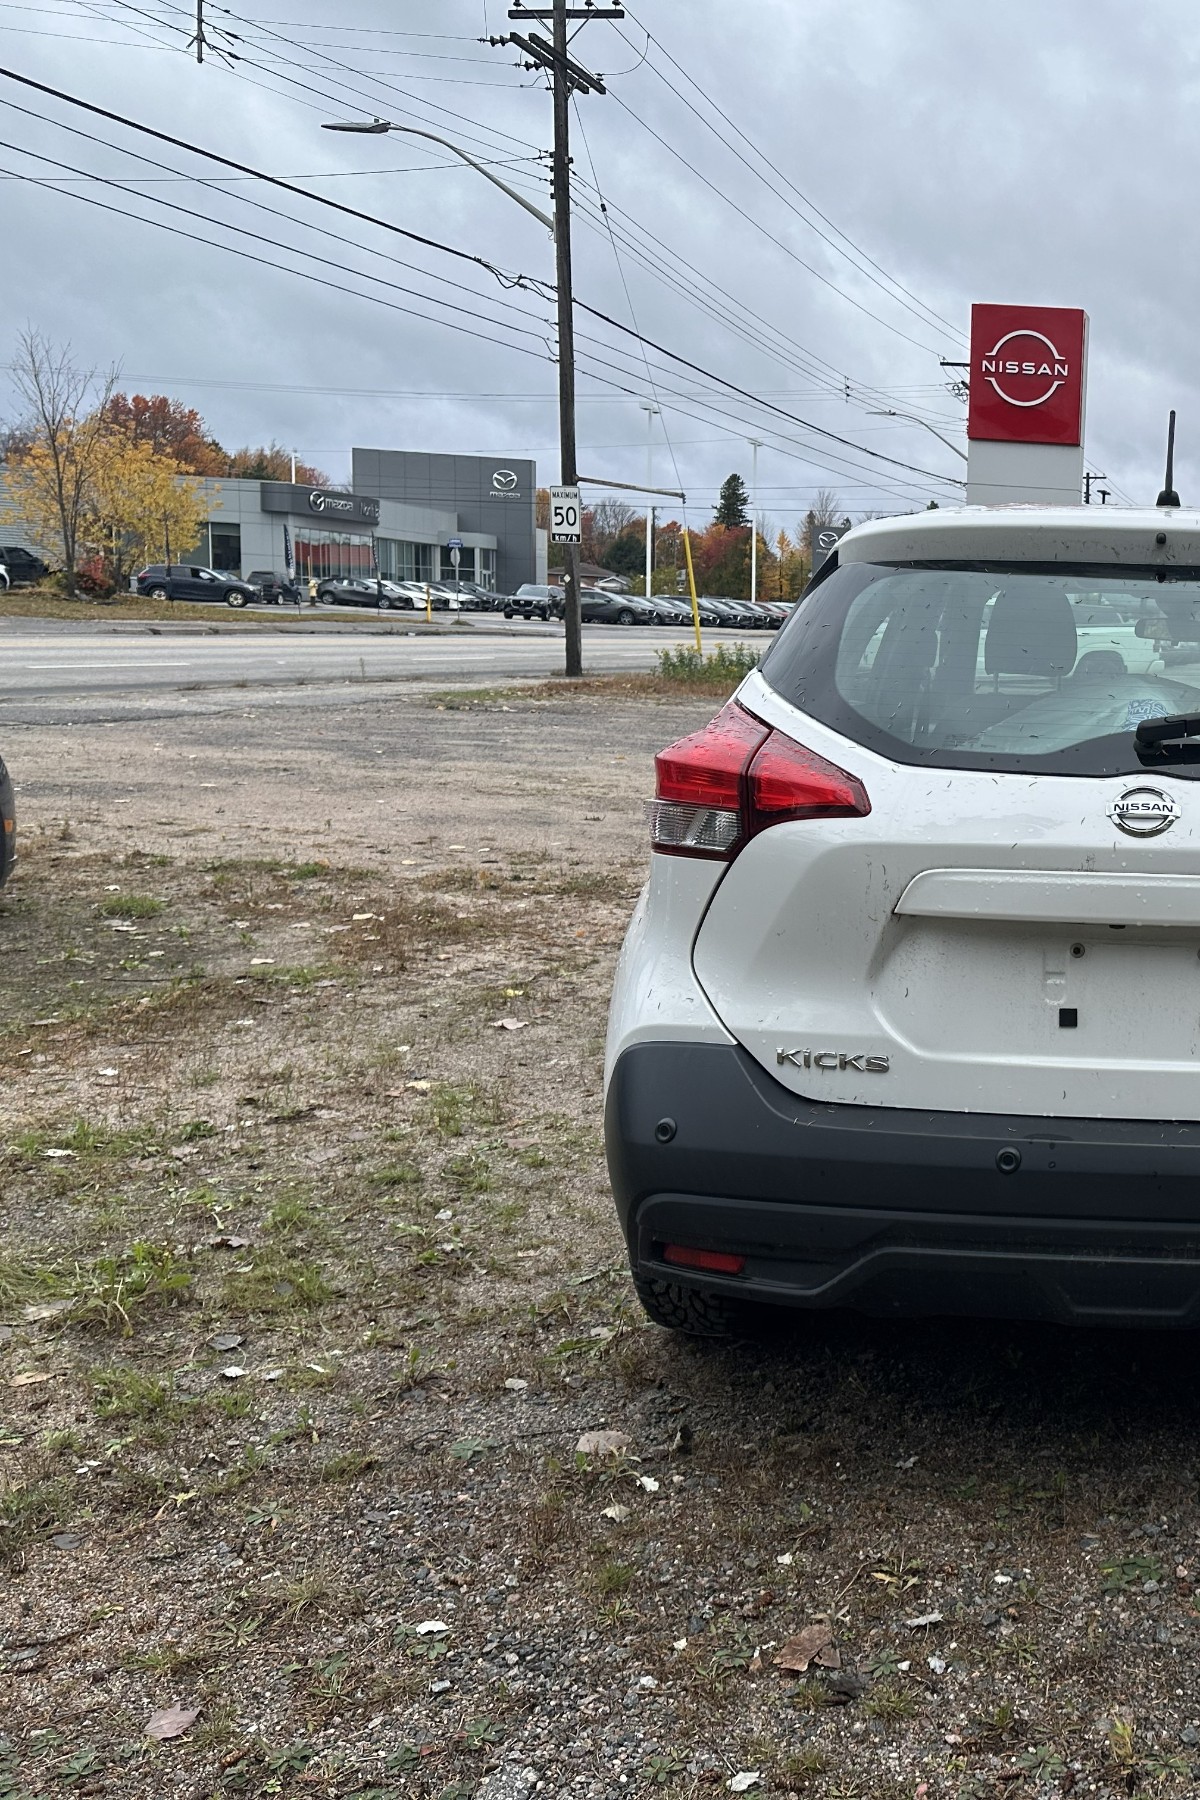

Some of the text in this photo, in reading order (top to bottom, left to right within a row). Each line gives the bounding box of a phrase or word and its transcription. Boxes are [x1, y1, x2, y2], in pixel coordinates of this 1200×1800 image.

[982, 360, 1068, 376] NISSAN
[554, 506, 577, 527] 50
[554, 534, 577, 542] km/h
[1113, 803, 1173, 813] NISSAN
[776, 1047, 890, 1073] KICKS
